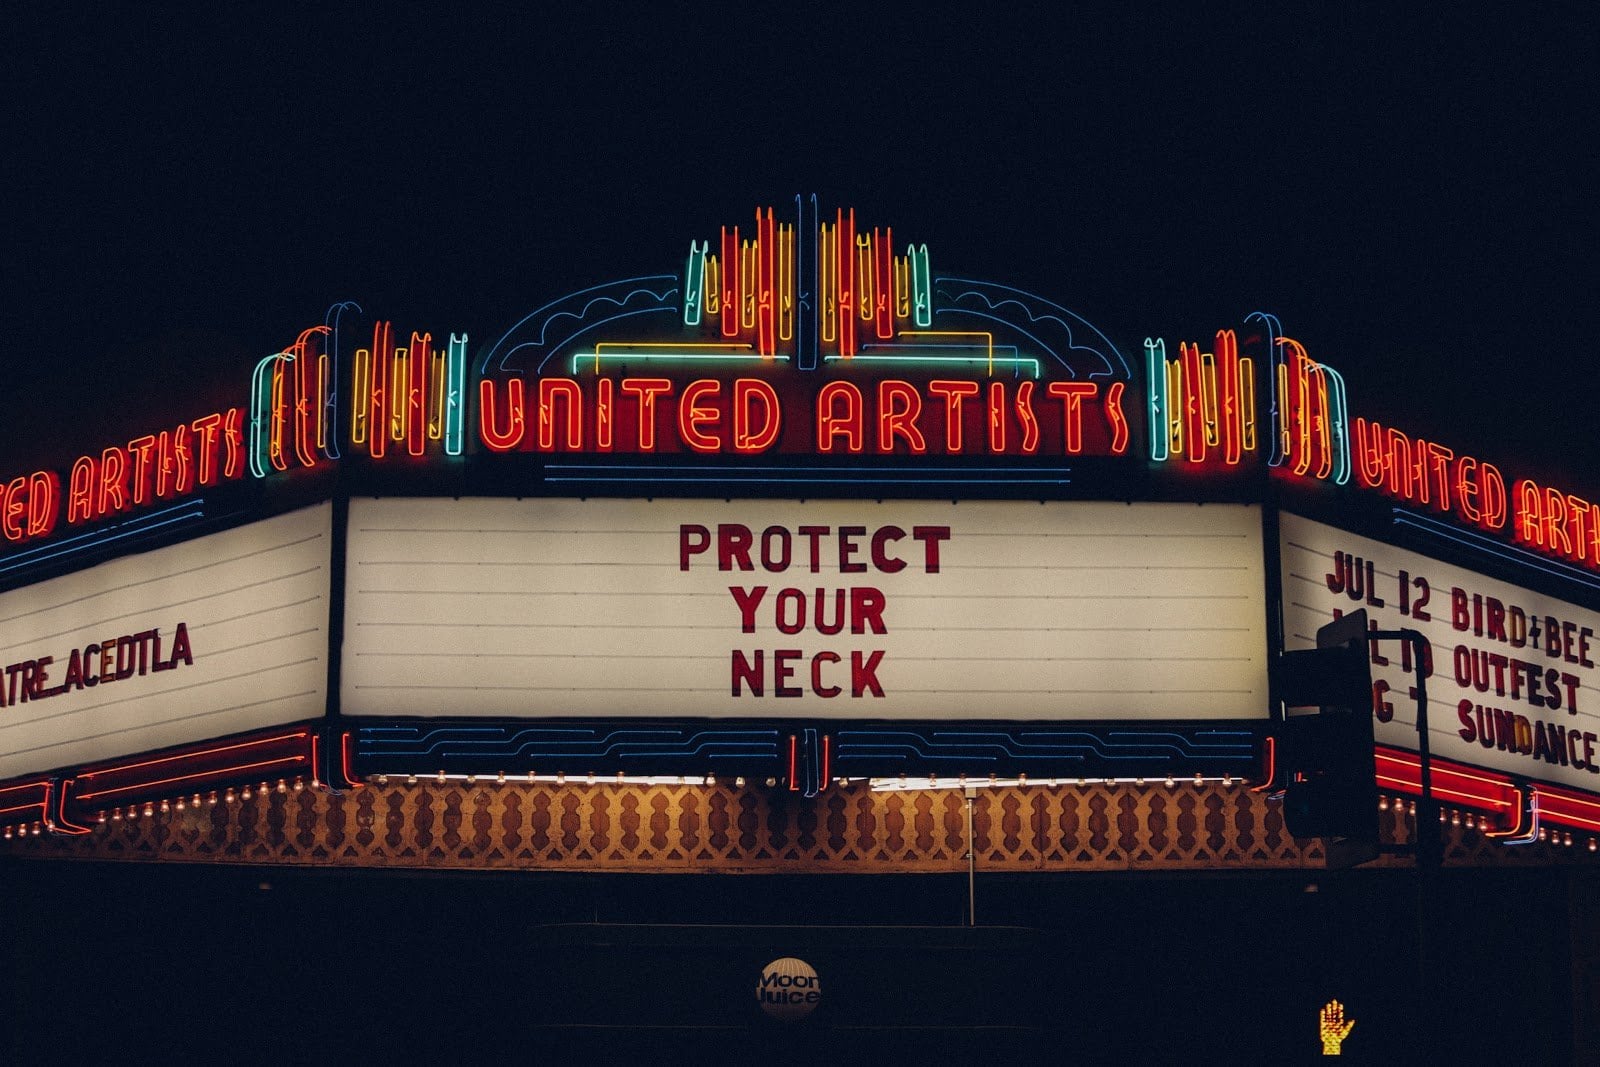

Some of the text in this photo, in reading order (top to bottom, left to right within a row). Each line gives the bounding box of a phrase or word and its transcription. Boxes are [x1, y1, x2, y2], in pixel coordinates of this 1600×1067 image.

[480, 378, 1129, 452] UNITED ARTISTS
[0, 408, 239, 540] ED ARTISTS
[1357, 417, 1506, 528] UNITED
[679, 524, 951, 574] PROTECT
[729, 586, 888, 635] YOUR
[1325, 550, 1384, 608] JUL
[1399, 570, 1431, 622] 12
[731, 649, 886, 698] NECK
[1453, 644, 1580, 715] OUTFEST
[1457, 699, 1600, 774] SUNDANCE
[756, 987, 821, 1004] Juice
[757, 972, 821, 989] Moon
